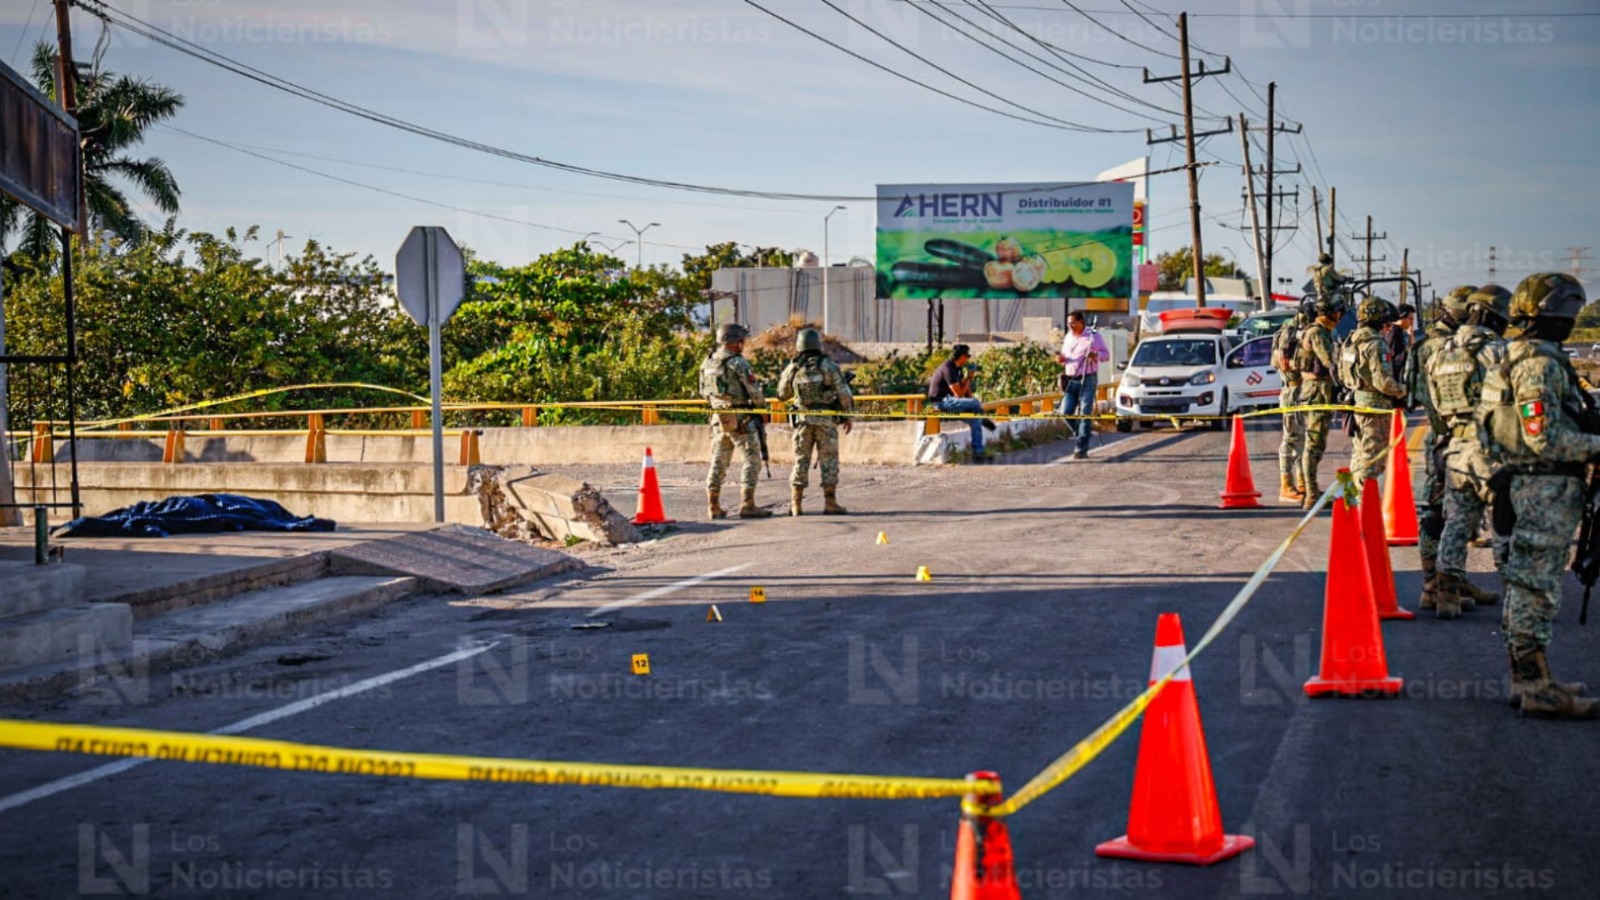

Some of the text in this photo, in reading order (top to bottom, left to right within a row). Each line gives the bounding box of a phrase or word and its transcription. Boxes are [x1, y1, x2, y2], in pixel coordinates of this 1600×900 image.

[893, 193, 1003, 217] AHERN
[1019, 196, 1111, 208] Distribuidor #1
[635, 659, 647, 668] 12
